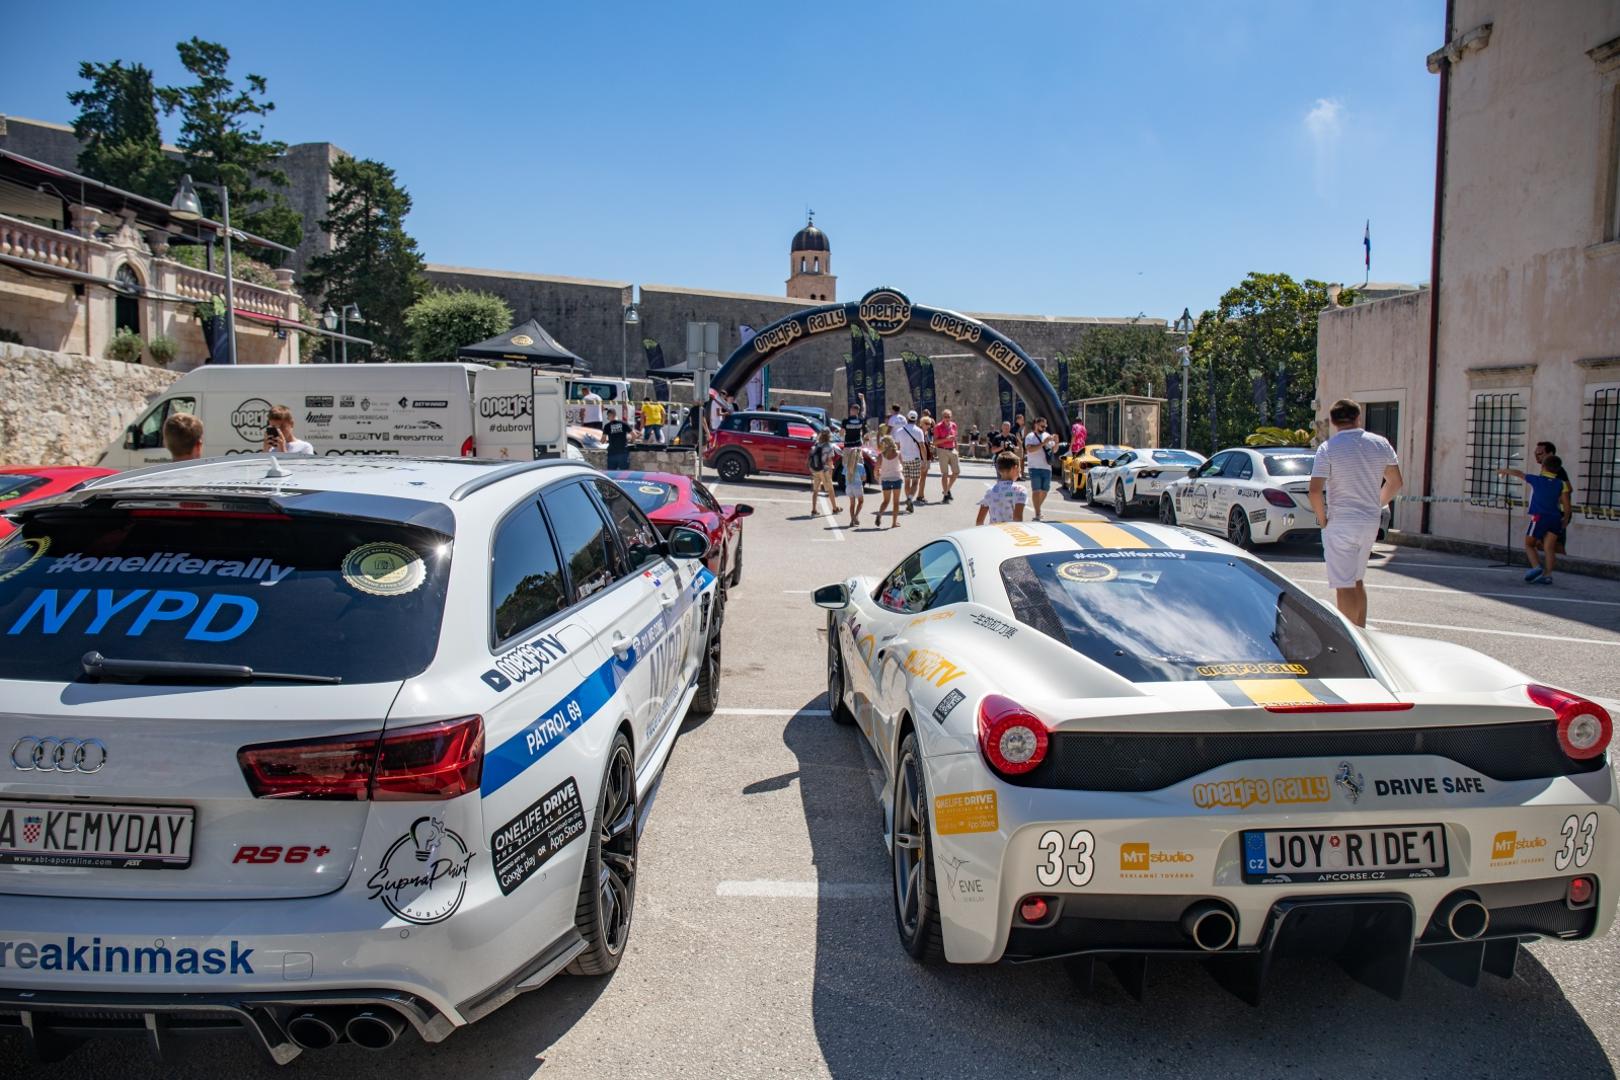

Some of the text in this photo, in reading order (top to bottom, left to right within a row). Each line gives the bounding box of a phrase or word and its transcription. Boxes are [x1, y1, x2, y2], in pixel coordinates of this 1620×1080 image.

[1073, 551, 1186, 560] #oneliferally
[47, 552, 296, 586] #oneliferally
[7, 589, 259, 642] NYPD
[526, 700, 582, 754] PATROL 69
[1374, 777, 1485, 796] DRIVE SAFE
[557, 797, 578, 815] GAME
[964, 794, 993, 805] DRIVE
[495, 782, 576, 850] ONELIFE DRIVE
[0, 809, 185, 854] A KEMYDAY
[1555, 811, 1598, 871] 33
[500, 820, 583, 886] Google play OR App Store
[1269, 831, 1437, 868] JOY RIDE1
[1495, 840, 1514, 851] MT
[123, 859, 142, 867] ABT
[1036, 829, 1095, 887] 33
[1123, 851, 1194, 863] MT studio
[1249, 859, 1264, 869] CZ
[1318, 872, 1385, 881] APCORSE.CZ
[960, 880, 983, 893] EWE
[406, 900, 453, 918] PUBLIC
[0, 936, 255, 975] reakinmask
